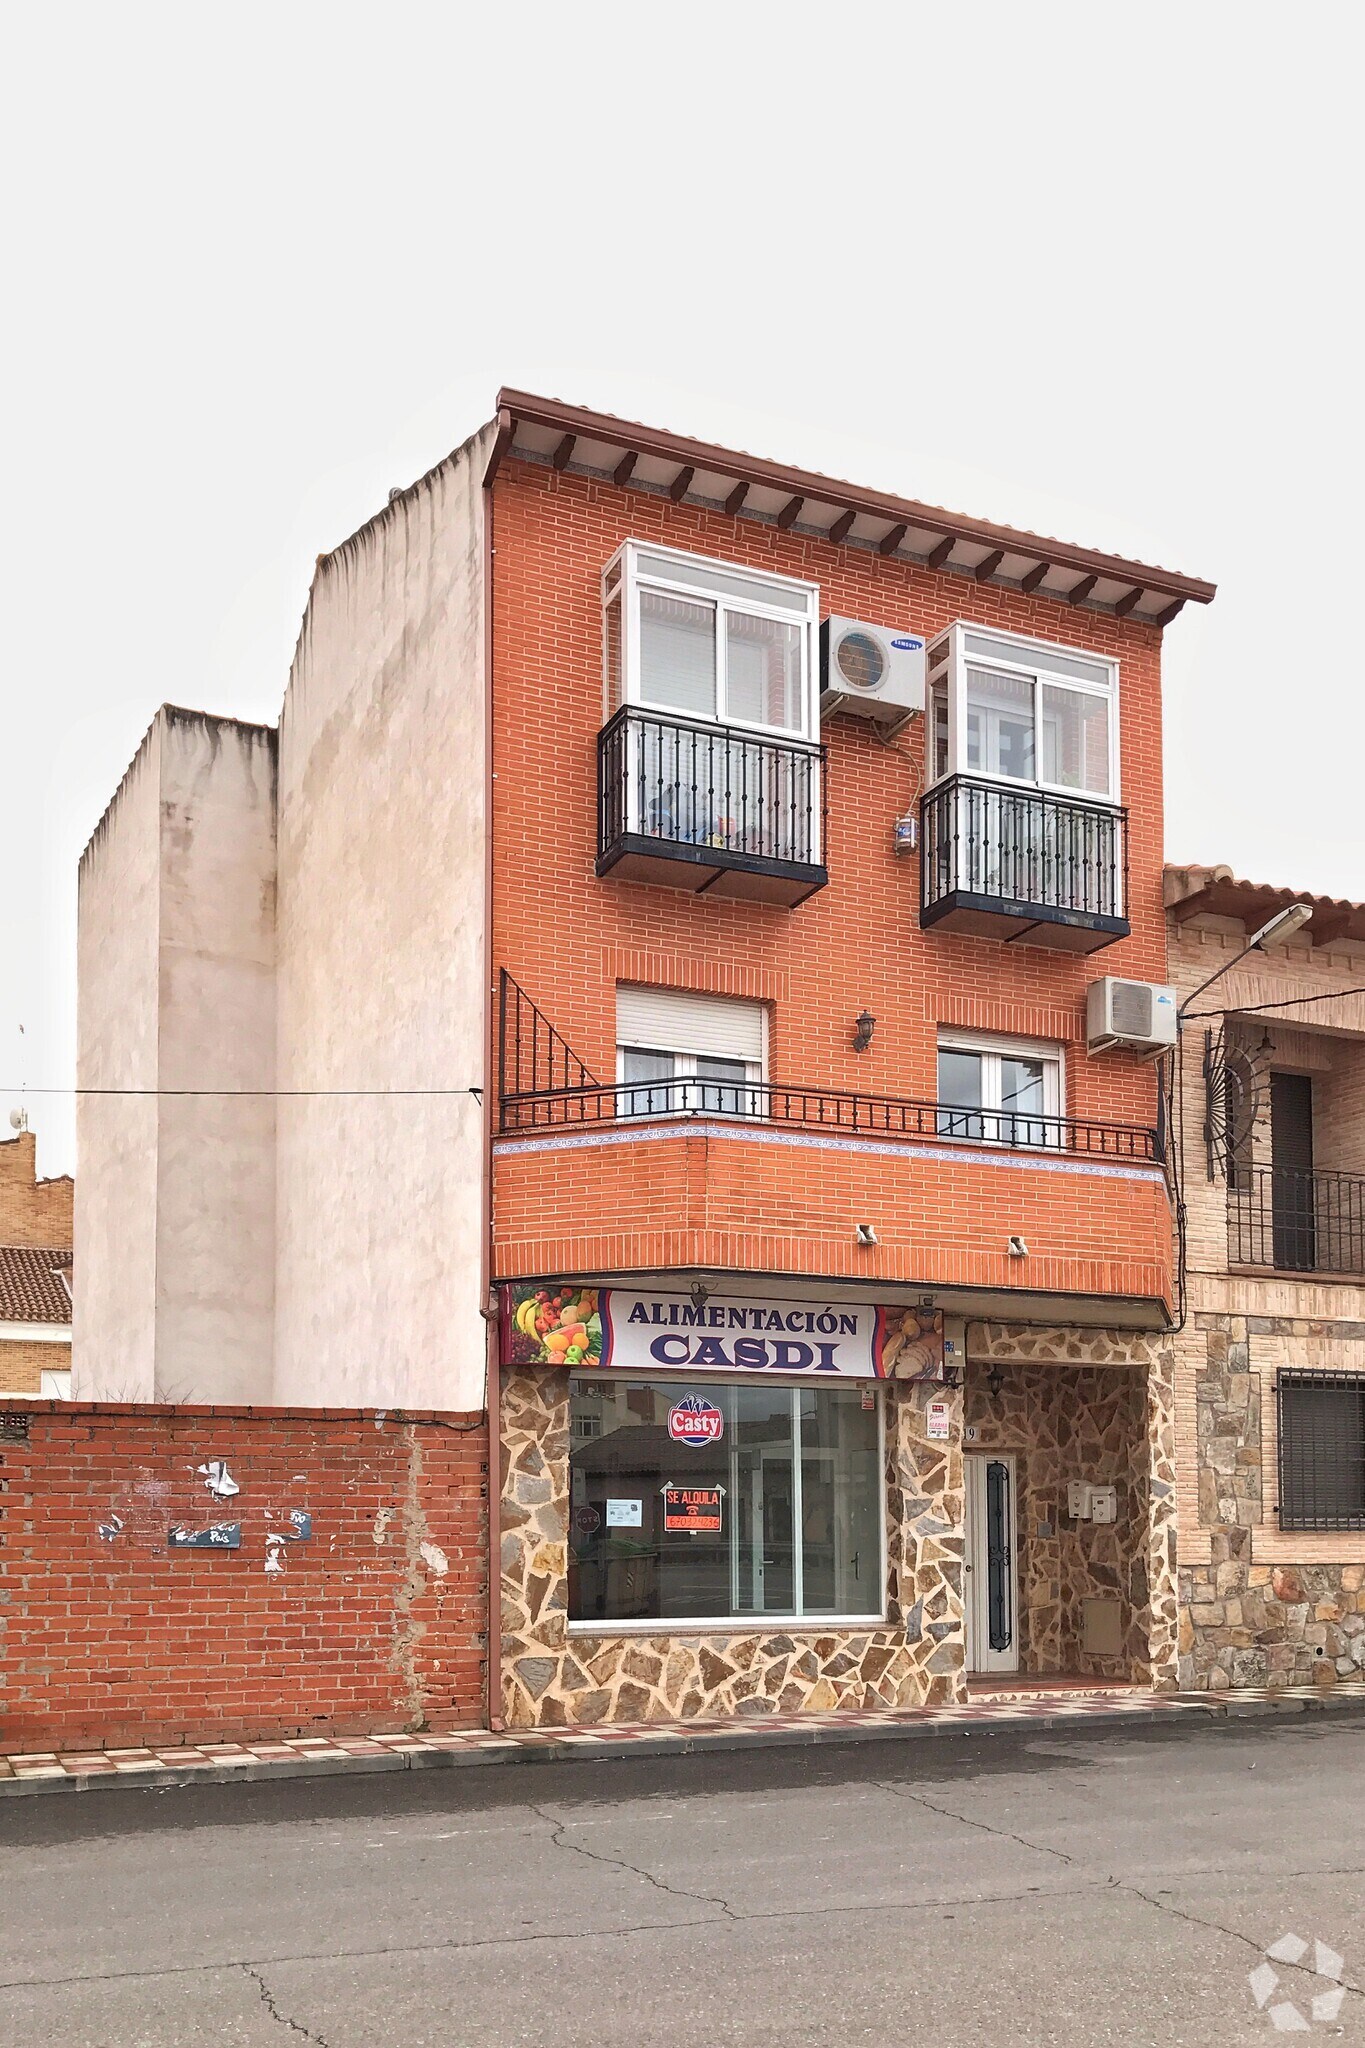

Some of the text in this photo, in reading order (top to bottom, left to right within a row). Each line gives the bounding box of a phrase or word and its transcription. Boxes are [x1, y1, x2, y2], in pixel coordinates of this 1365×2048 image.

[627, 1301, 859, 1336] ALIMENTACIÓN
[649, 1333, 842, 1372] CASDI
[672, 1412, 720, 1436] Casty
[667, 1490, 719, 1505] SE ALQUILA
